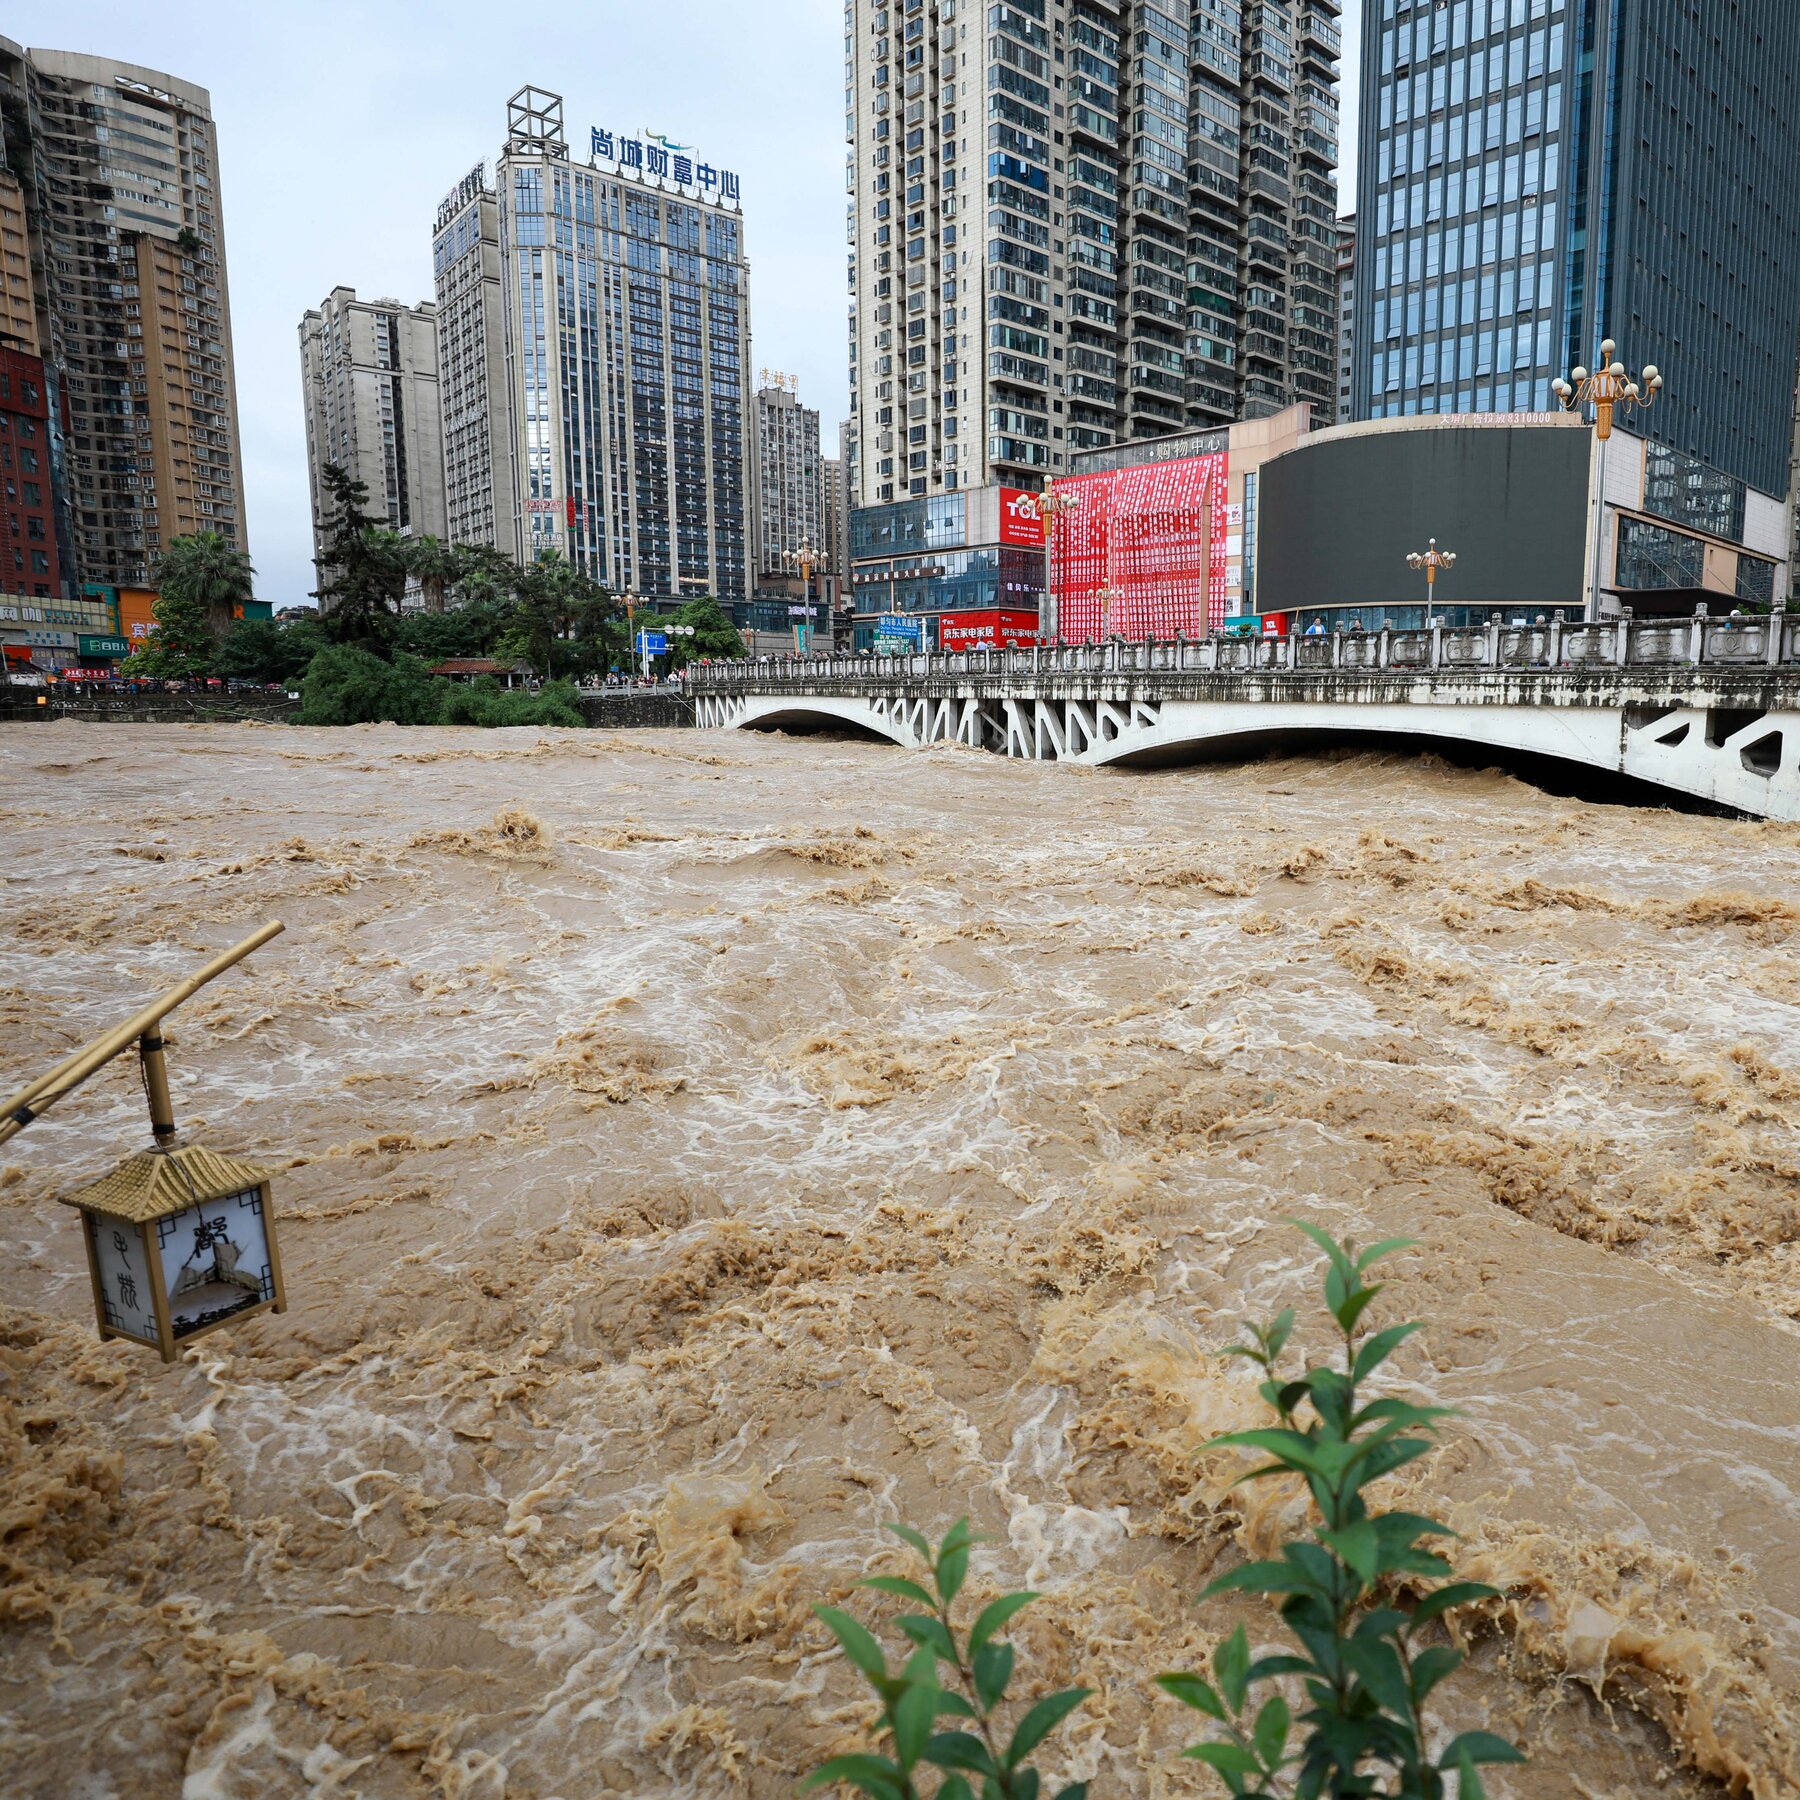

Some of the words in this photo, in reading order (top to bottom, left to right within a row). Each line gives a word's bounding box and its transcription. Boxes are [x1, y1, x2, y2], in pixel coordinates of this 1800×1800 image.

[591, 125, 740, 200] 尚城财富中心
[1156, 435, 1220, 460] 购物中心
[1006, 501, 1041, 521] TCL
[880, 617, 918, 628] 都匀市人民医院
[943, 626, 994, 639] 京东家电家居
